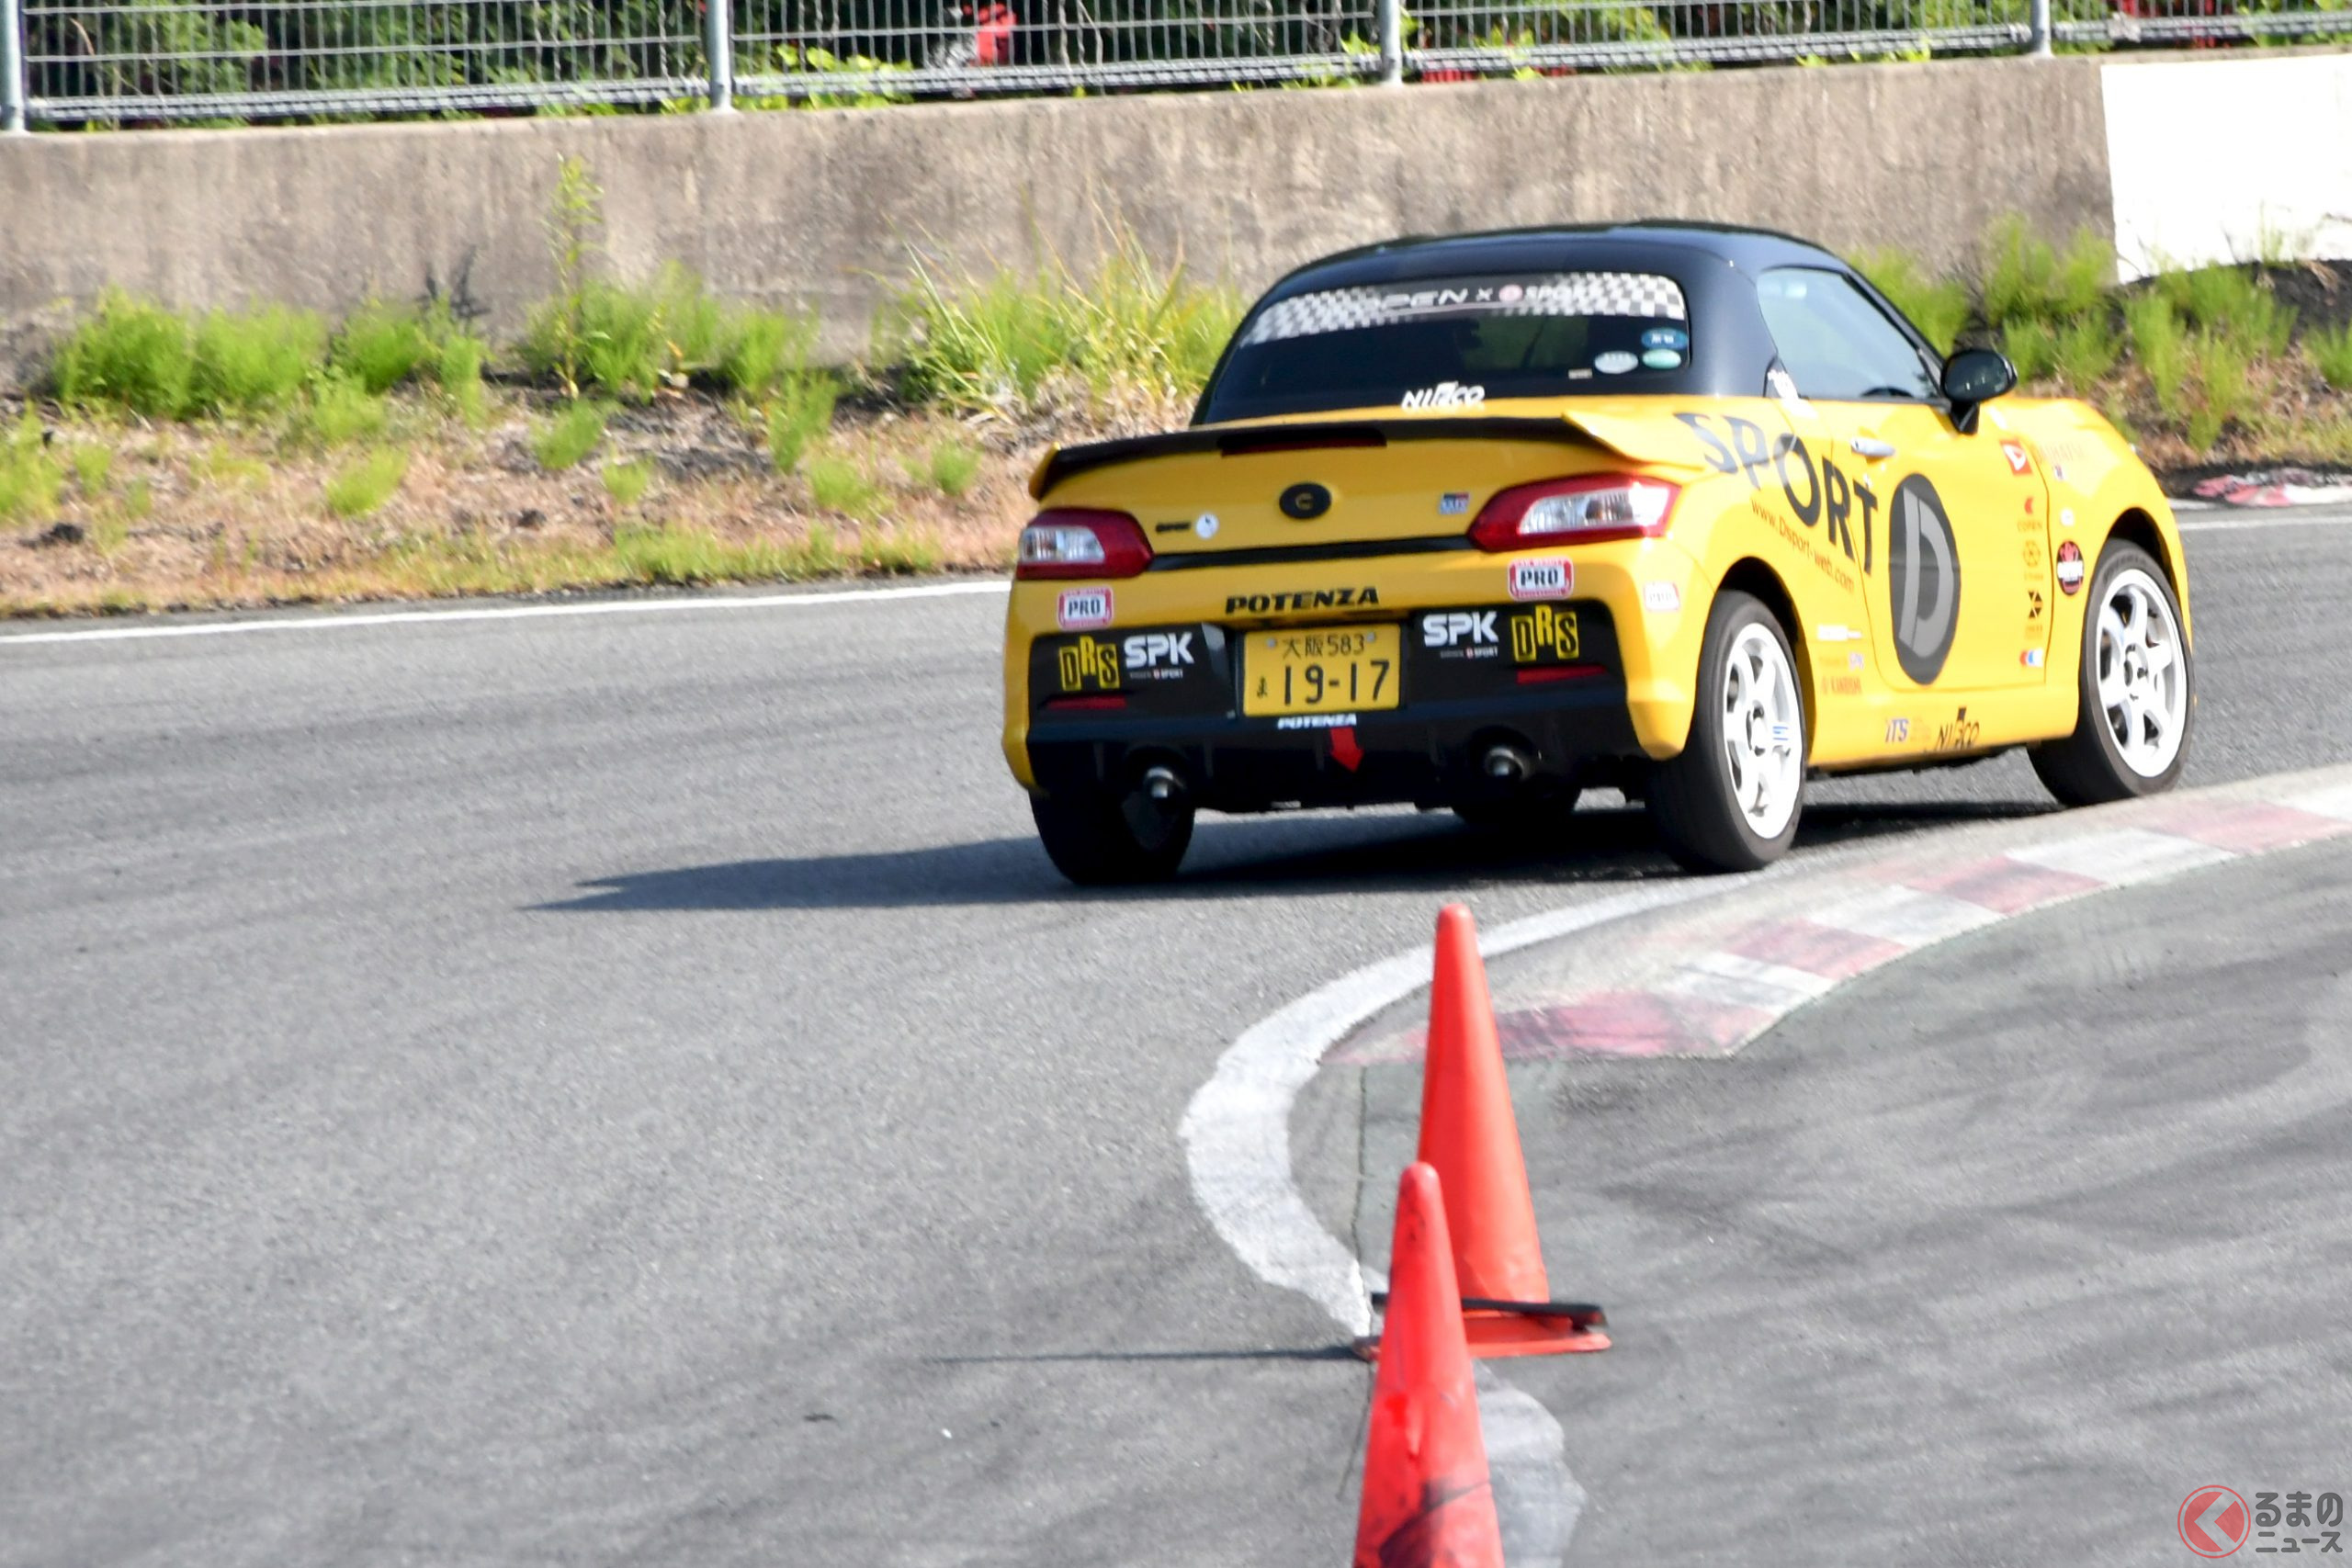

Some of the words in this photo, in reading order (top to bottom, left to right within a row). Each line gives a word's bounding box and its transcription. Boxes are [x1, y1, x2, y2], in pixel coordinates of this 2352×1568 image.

[1673, 412, 1879, 576] SPORT
[1521, 569, 1559, 586] PRO
[1069, 599, 1101, 615] PRO
[1225, 586, 1379, 615] POTENZA
[1423, 611, 1499, 647] SPK
[1124, 632, 1194, 669] SPK
[1284, 660, 1390, 706] 19-17
[1278, 714, 1357, 729] POTENZA
